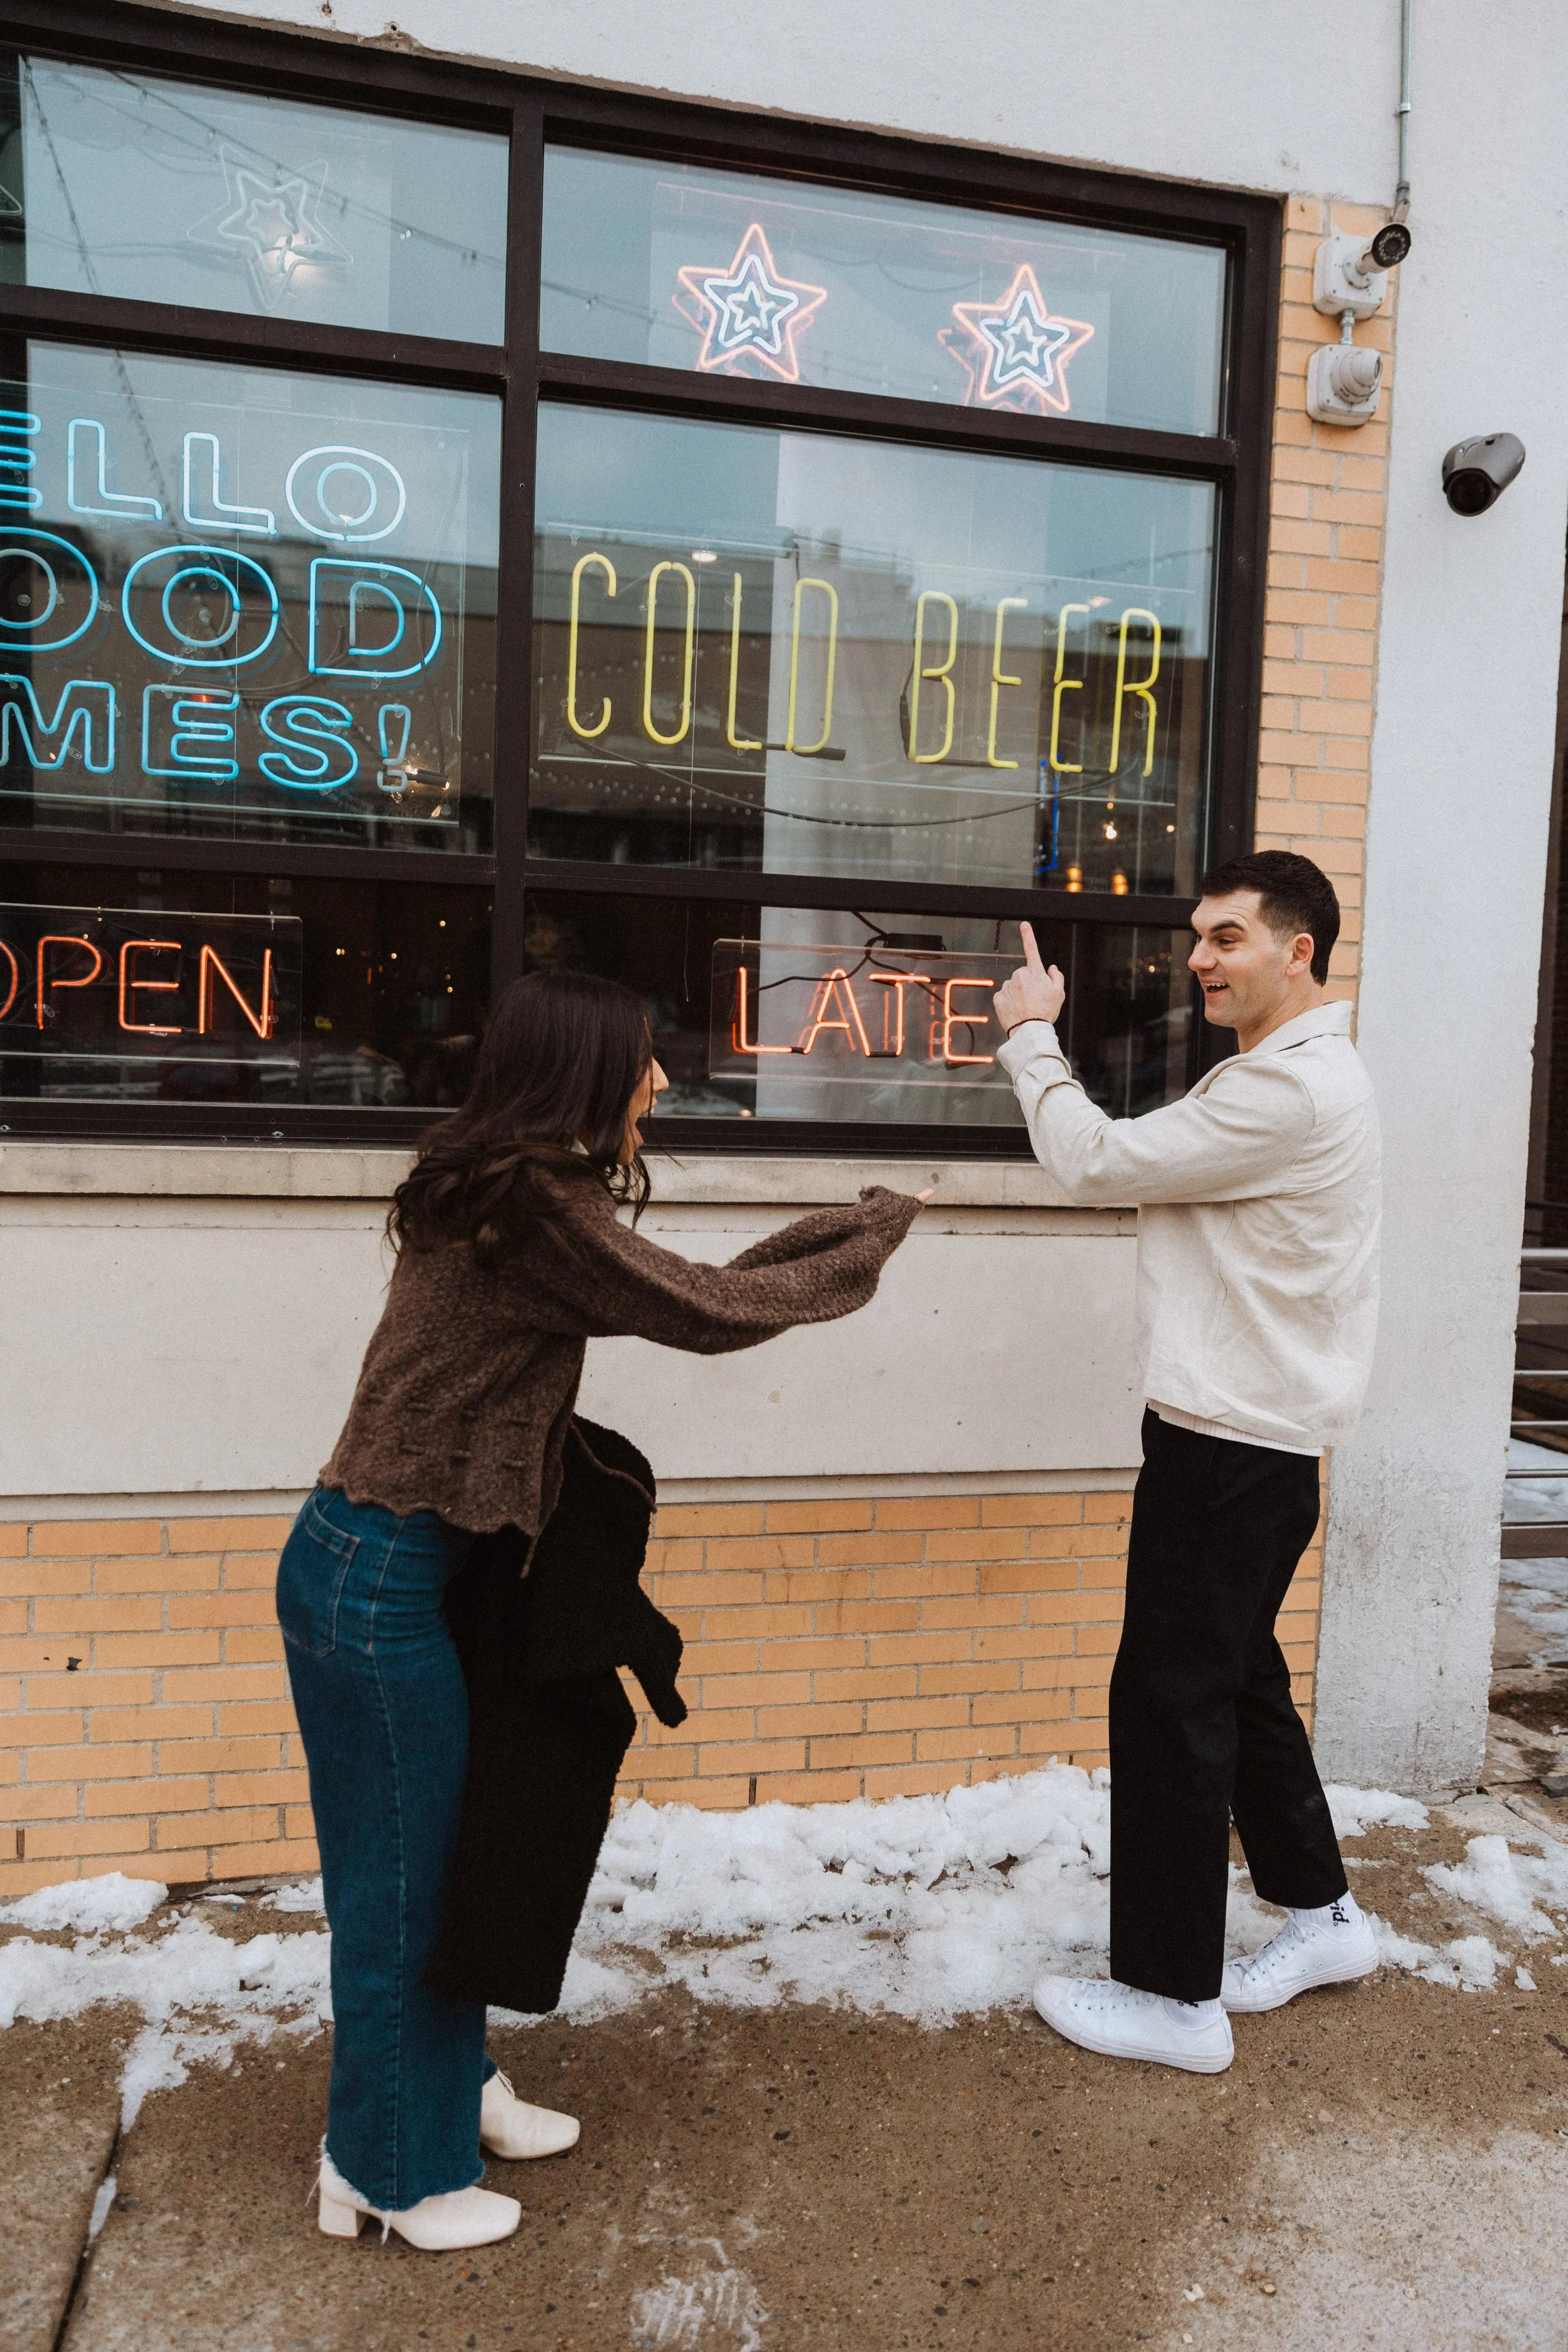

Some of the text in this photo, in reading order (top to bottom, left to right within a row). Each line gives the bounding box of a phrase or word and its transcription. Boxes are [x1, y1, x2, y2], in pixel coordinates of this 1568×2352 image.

[0, 526, 442, 679] OOD
[566, 552, 1161, 777] COLD BEER
[0, 673, 411, 792] MES!
[0, 935, 272, 1039] PEN
[739, 967, 995, 1063] LATE
